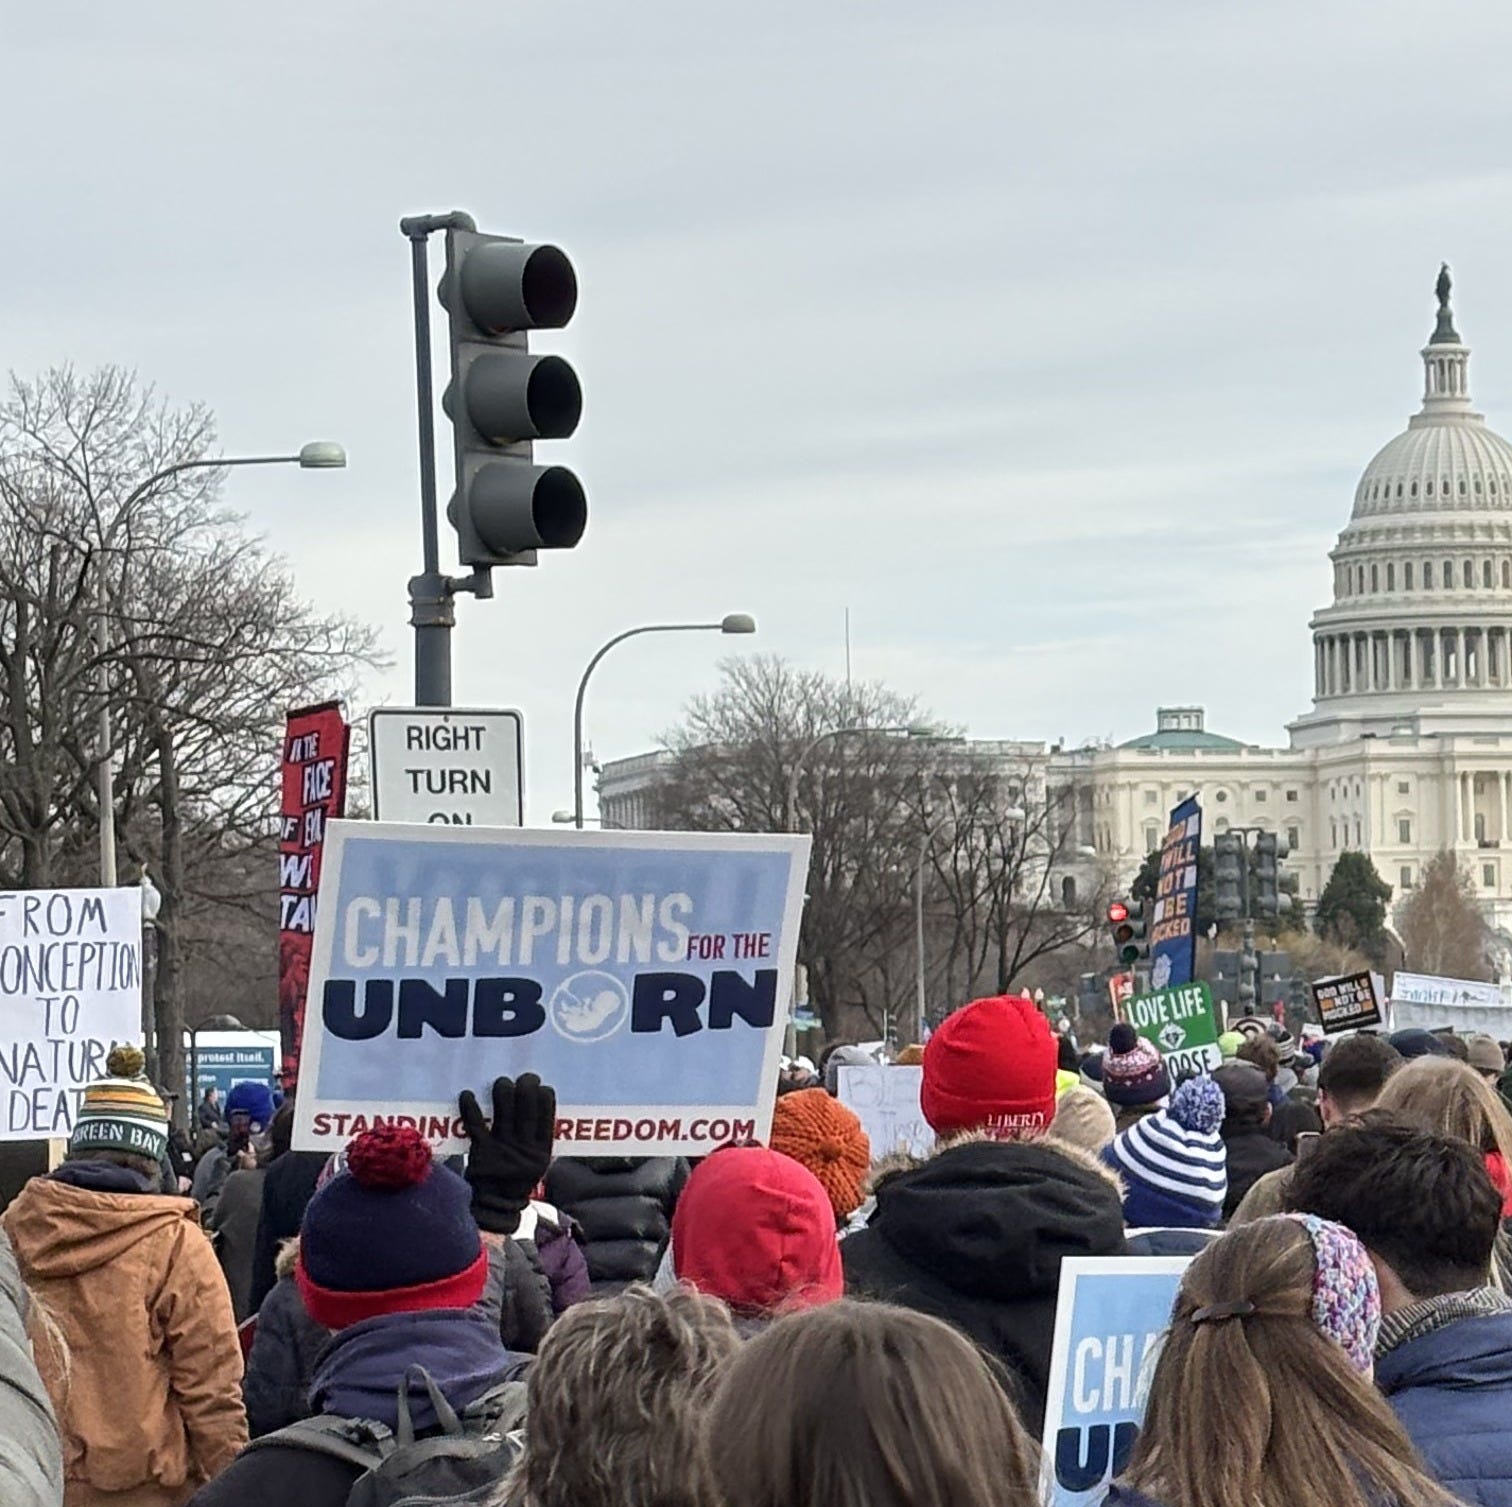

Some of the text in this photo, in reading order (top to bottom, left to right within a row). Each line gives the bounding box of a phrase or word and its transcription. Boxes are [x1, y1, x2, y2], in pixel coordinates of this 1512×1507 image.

[406, 725, 486, 751] RIGHT
[303, 760, 335, 806] FACE
[405, 768, 491, 794] TURN
[343, 892, 693, 968] CHAMPIONS
[686, 934, 724, 961] FOR
[733, 931, 772, 958] THE
[0, 941, 139, 994] ONCEPTION
[36, 995, 80, 1037] TO
[1126, 987, 1206, 1030] LOVE LIFE
[0, 1039, 131, 1087] NATUR
[1168, 1049, 1212, 1083] OOSE
[9, 1087, 87, 1132] DEAT
[73, 1122, 161, 1155] GREEN BAY
